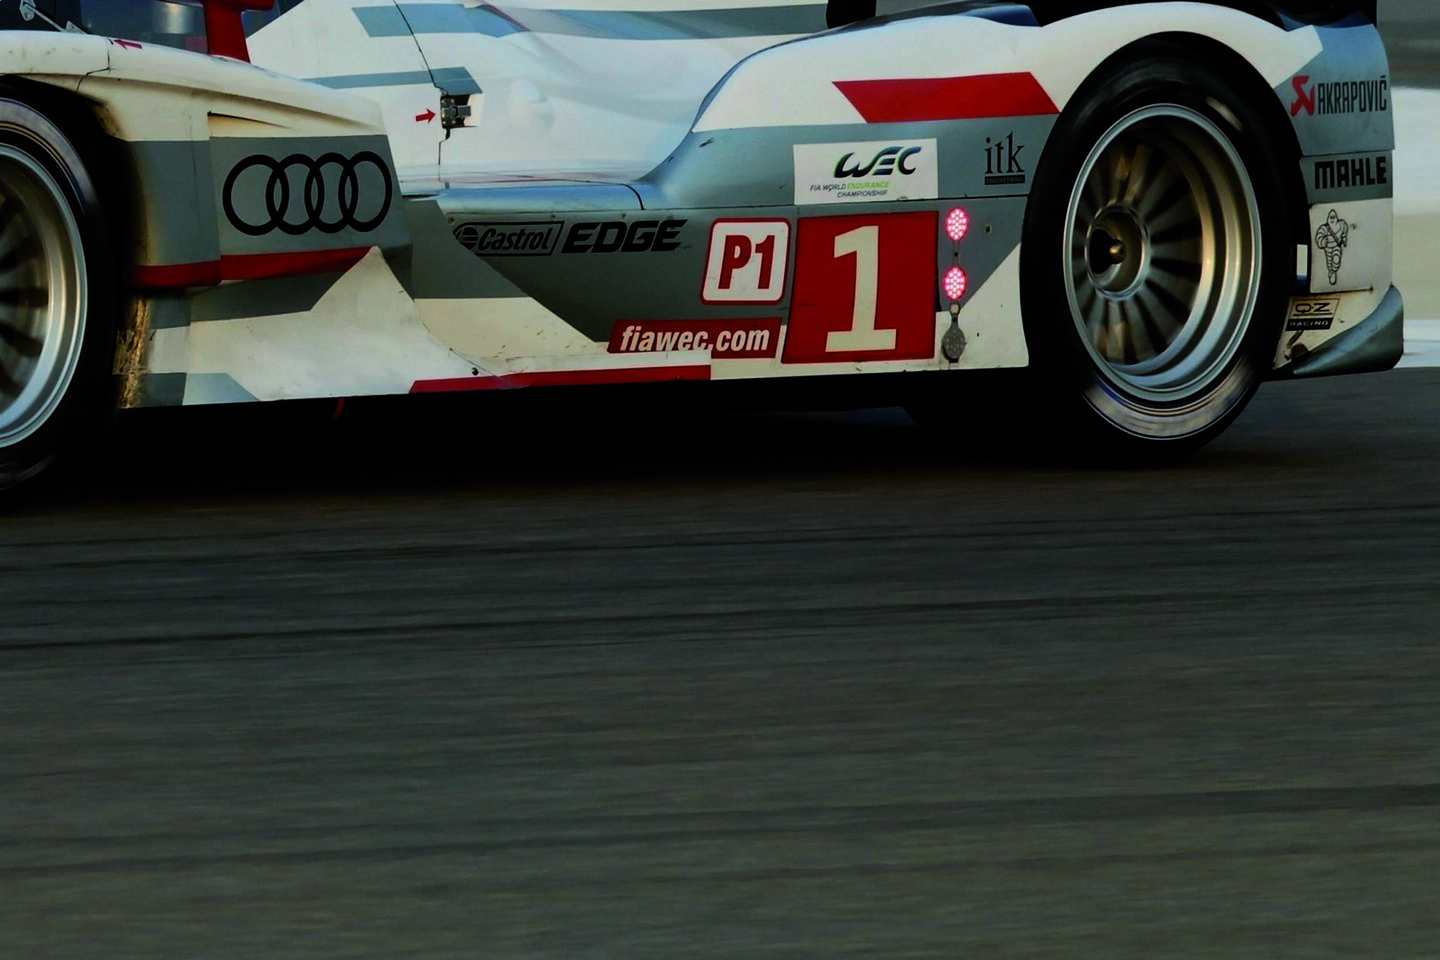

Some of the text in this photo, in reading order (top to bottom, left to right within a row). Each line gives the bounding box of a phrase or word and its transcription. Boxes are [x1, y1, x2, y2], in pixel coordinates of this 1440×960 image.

[833, 145, 922, 179] WEC
[984, 131, 1026, 175] itk
[822, 183, 847, 191] WORLD
[1314, 155, 1388, 191] MAHLE
[477, 218, 689, 254] Castrol EDGE
[718, 234, 776, 290] P1
[825, 225, 897, 353] 1
[619, 325, 771, 353] fiawec.com
